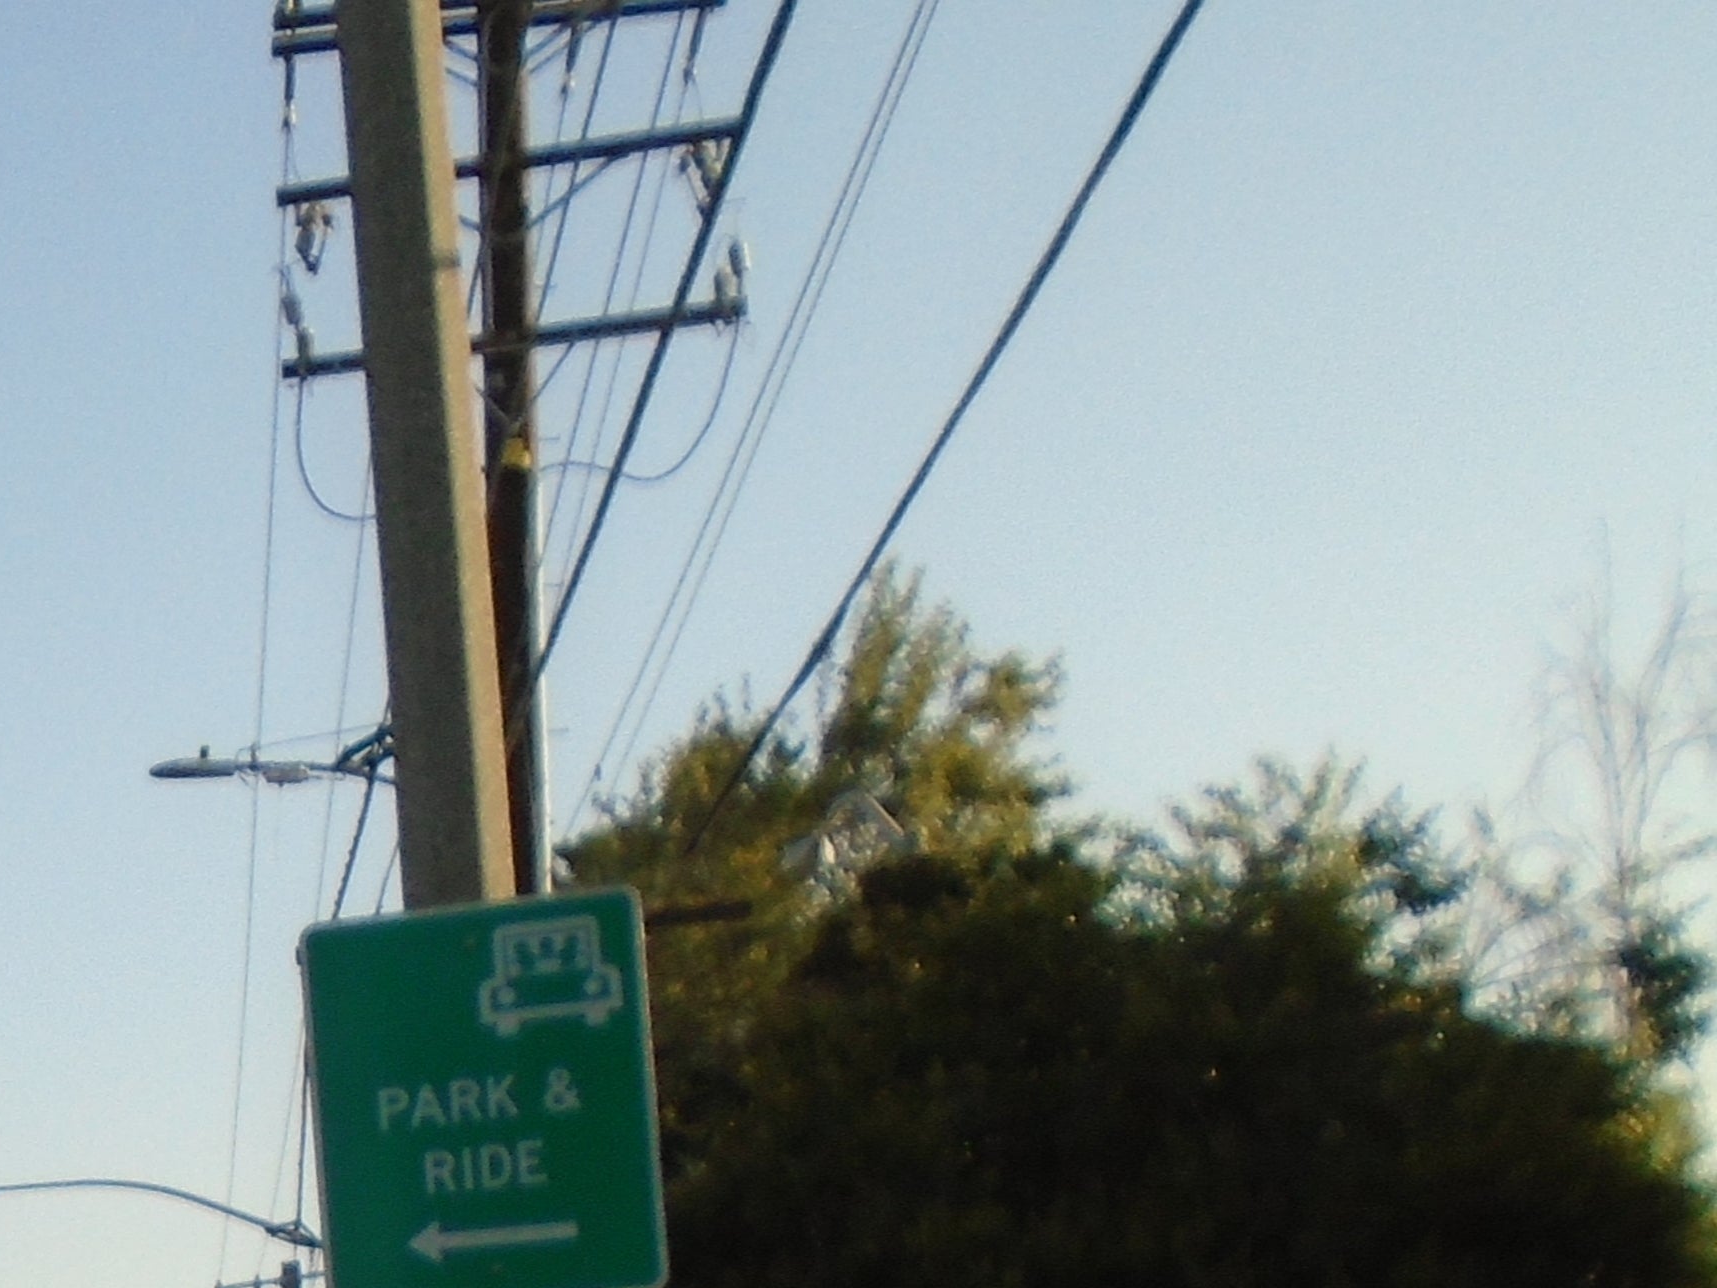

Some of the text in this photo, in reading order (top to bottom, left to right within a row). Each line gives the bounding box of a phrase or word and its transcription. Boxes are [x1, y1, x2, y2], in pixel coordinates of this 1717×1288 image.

[377, 1067, 581, 1132] PARK &
[423, 1139, 550, 1195] RIDE
